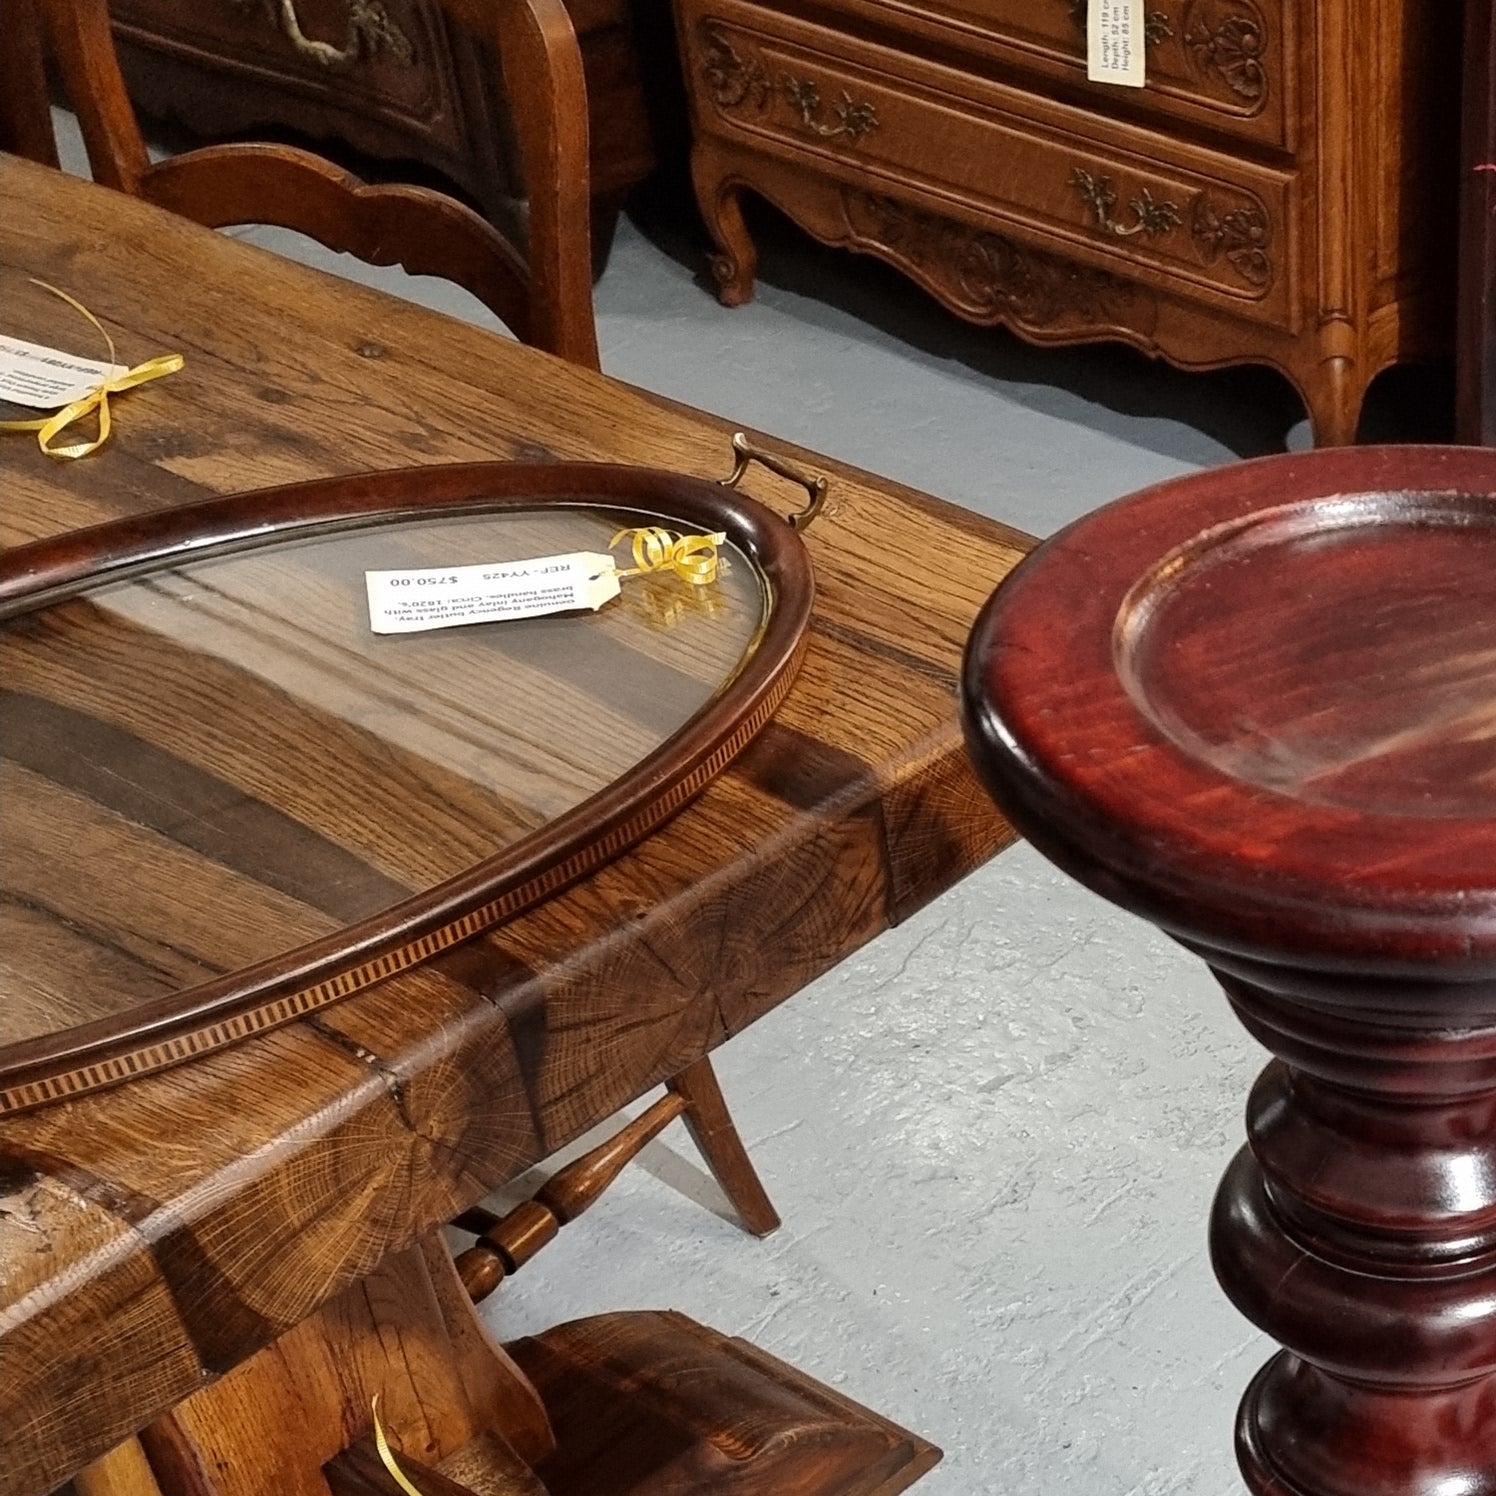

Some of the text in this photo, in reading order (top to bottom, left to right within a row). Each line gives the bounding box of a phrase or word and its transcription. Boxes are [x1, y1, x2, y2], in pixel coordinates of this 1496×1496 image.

[1113, 6, 1119, 22] cm
[1123, 5, 1129, 21] cm
[1101, 32, 1110, 69] Length:
[1111, 38, 1120, 69] Depth:
[1121, 37, 1131, 71] Height:
[389, 575, 459, 587] $750.00
[485, 591, 538, 599] handles.
[540, 585, 574, 594] brass
[511, 592, 574, 604] Mahogany
[416, 606, 449, 614] glass
[428, 611, 465, 620] butler
[468, 606, 521, 616] Regency
